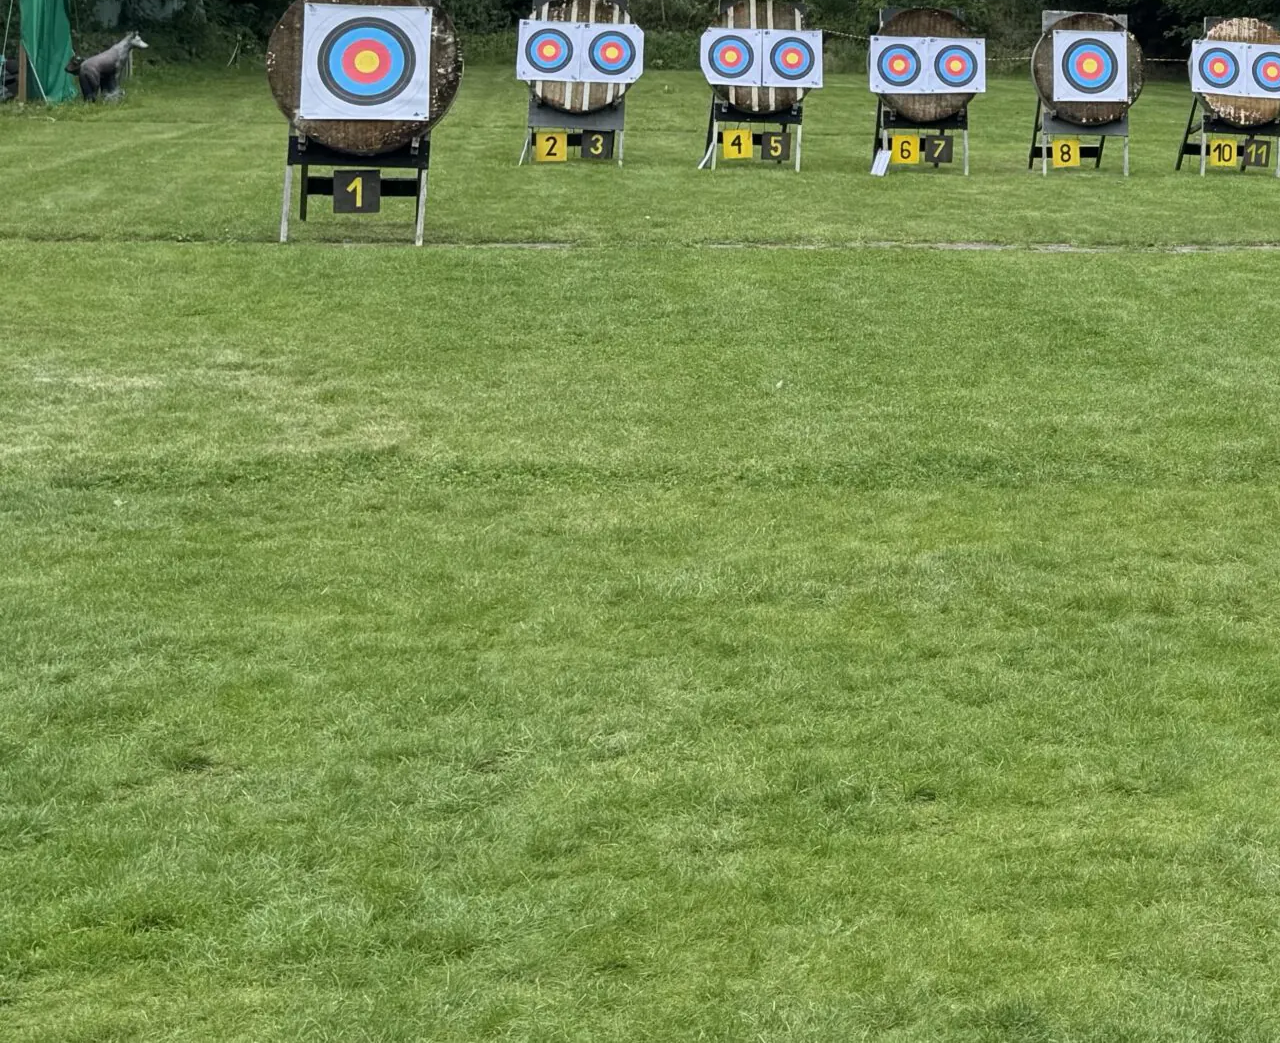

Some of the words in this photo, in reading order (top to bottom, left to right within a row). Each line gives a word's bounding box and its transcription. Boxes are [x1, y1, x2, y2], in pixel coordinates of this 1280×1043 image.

[545, 136, 557, 156] 2
[590, 134, 603, 155] 3
[731, 135, 742, 155] 4
[770, 136, 782, 156] 5
[900, 140, 911, 159] 6
[933, 141, 944, 158] 7
[1060, 144, 1070, 162] 8
[1213, 144, 1232, 162] 10
[1248, 144, 1267, 163] 11
[346, 177, 362, 207] 1
